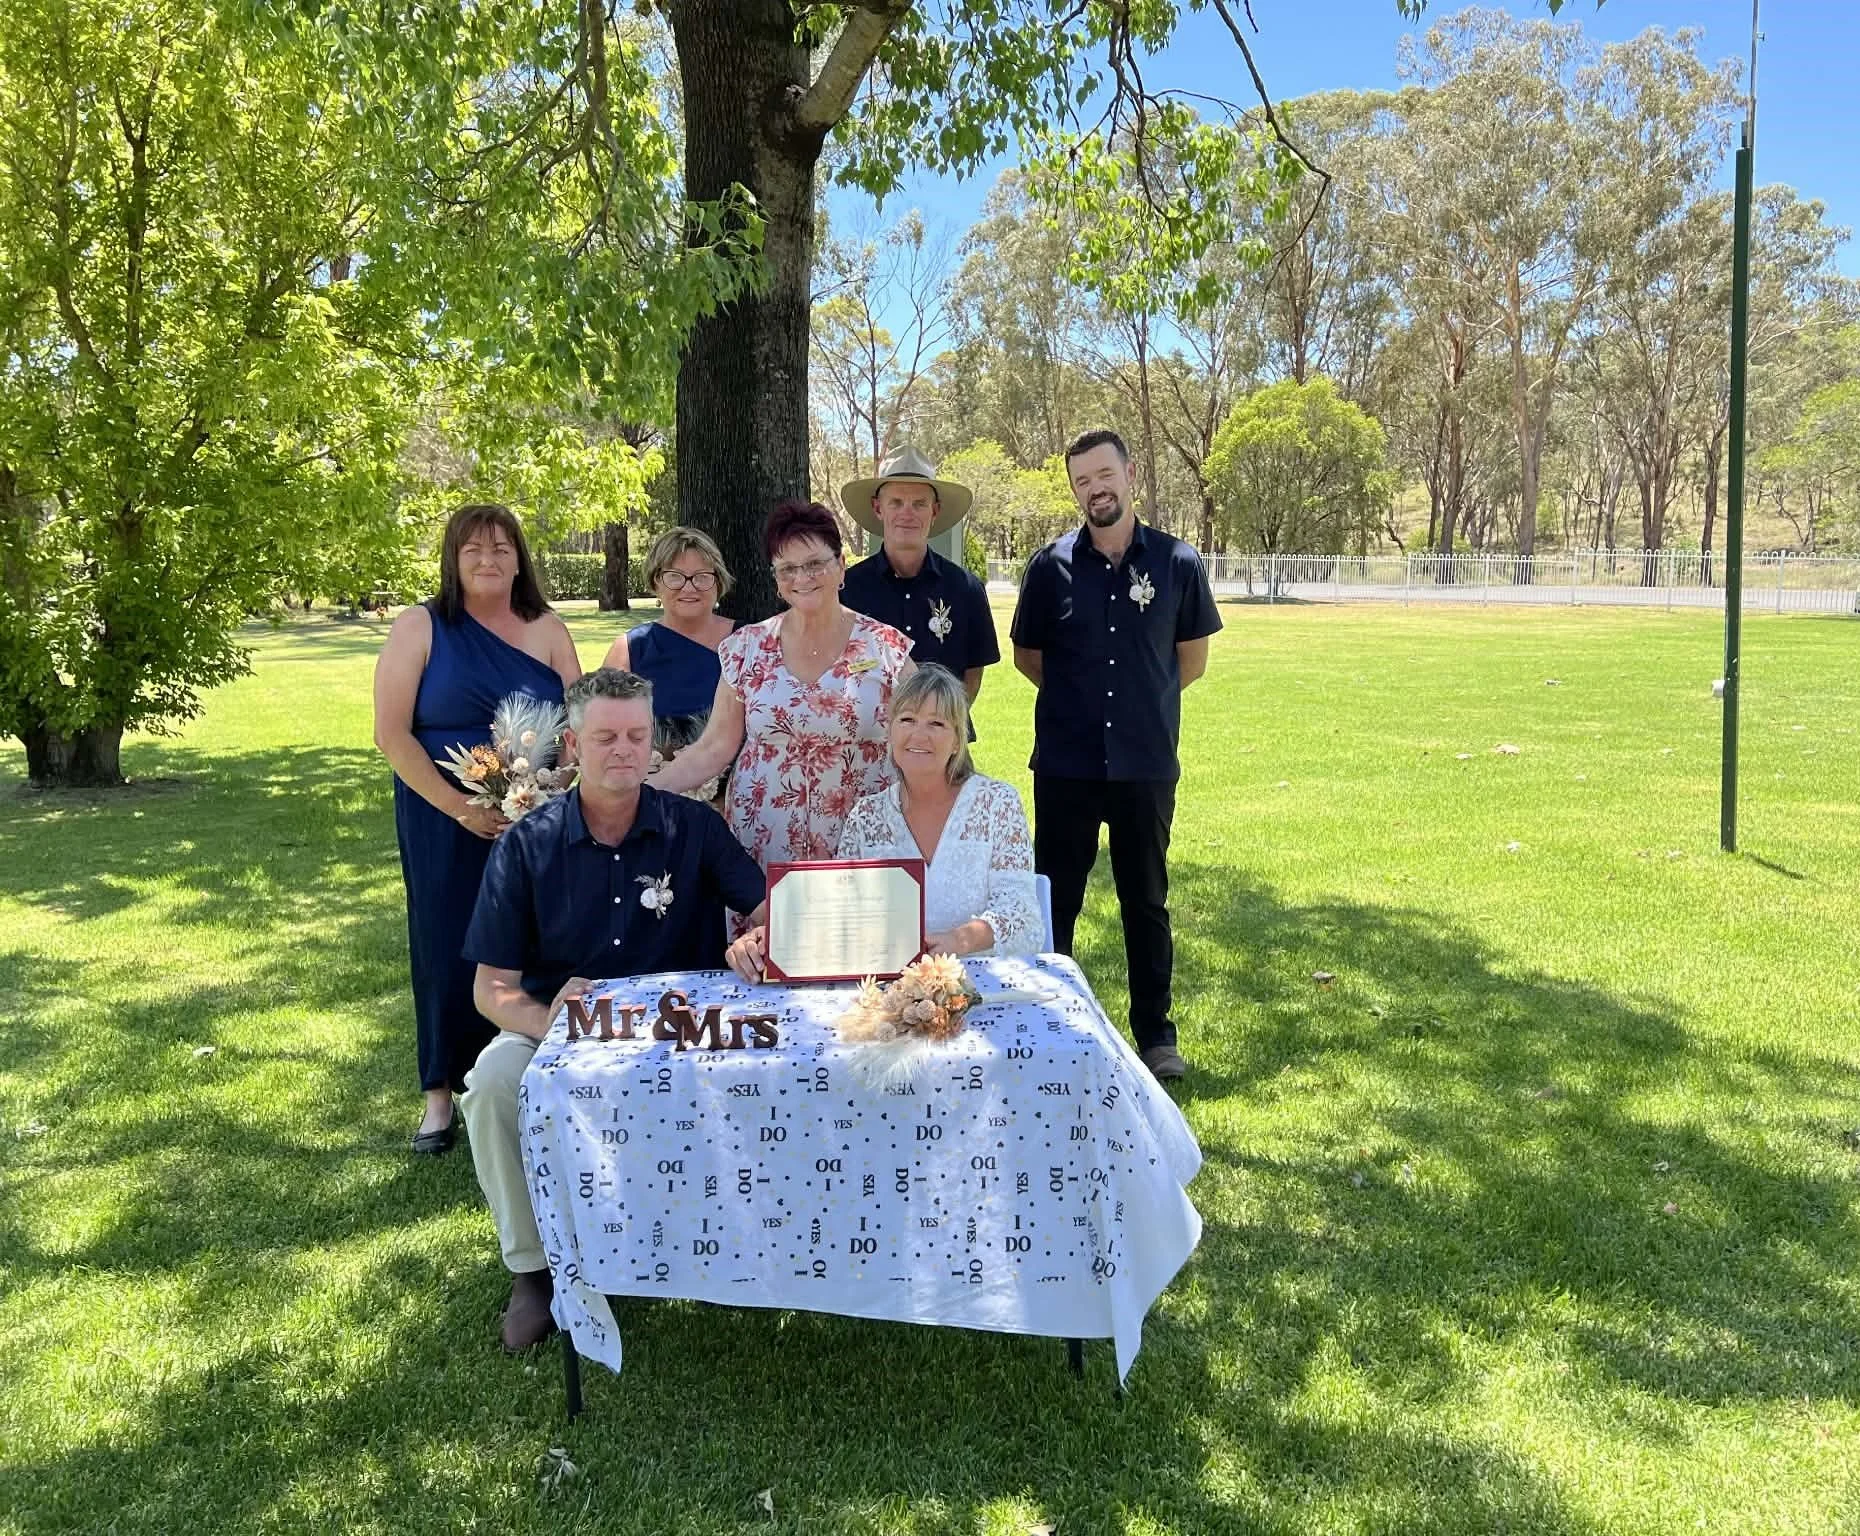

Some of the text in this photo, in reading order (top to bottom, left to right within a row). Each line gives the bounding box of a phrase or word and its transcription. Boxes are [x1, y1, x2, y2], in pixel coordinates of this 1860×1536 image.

[564, 994, 647, 1040] Mr
[653, 990, 689, 1040] &
[671, 1005, 779, 1051] Mrs
[697, 1055, 725, 1063] DO
[1008, 1047, 1033, 1059] DO
[658, 1068, 672, 1093] DO
[816, 1067, 829, 1092] DO
[970, 1065, 983, 1089] DO
[576, 1086, 603, 1099] YES
[733, 1084, 760, 1096] YES
[889, 1081, 916, 1096] YES
[1044, 1083, 1071, 1095] YES
[1102, 1085, 1120, 1110] DO
[612, 1108, 619, 1122] I
[770, 1106, 776, 1120] I
[926, 1104, 932, 1118] I
[675, 1120, 695, 1130] YES
[834, 1120, 853, 1129] YES
[988, 1117, 1007, 1127] YES
[601, 1129, 629, 1144] DO
[760, 1127, 787, 1142] DO
[916, 1125, 943, 1141] DO
[1070, 1126, 1088, 1140] DO
[1107, 1138, 1124, 1153] YES
[657, 1160, 684, 1174] DO
[816, 1159, 842, 1172] DO
[971, 1156, 997, 1170] DO
[579, 1172, 593, 1198] DO
[668, 1180, 674, 1192] I
[705, 1175, 717, 1199] YES
[738, 1168, 752, 1194] DO
[825, 1178, 831, 1191] I
[863, 1174, 875, 1197] YES
[896, 1168, 909, 1193] DO
[981, 1176, 986, 1189] I
[1016, 1172, 1029, 1195] YES
[1050, 1167, 1063, 1192] DO
[603, 1223, 623, 1233] YES
[702, 1218, 709, 1233] I
[762, 1218, 782, 1228] YES
[860, 1216, 866, 1231] I
[920, 1217, 939, 1227] YES
[1014, 1215, 1021, 1229] I
[652, 1226, 663, 1247] YES
[810, 1224, 821, 1245] YES
[967, 1223, 977, 1244] YES
[693, 1240, 719, 1255] DO
[849, 1238, 877, 1254] DO
[1005, 1236, 1031, 1252] DO
[1092, 1256, 1116, 1278] DO
